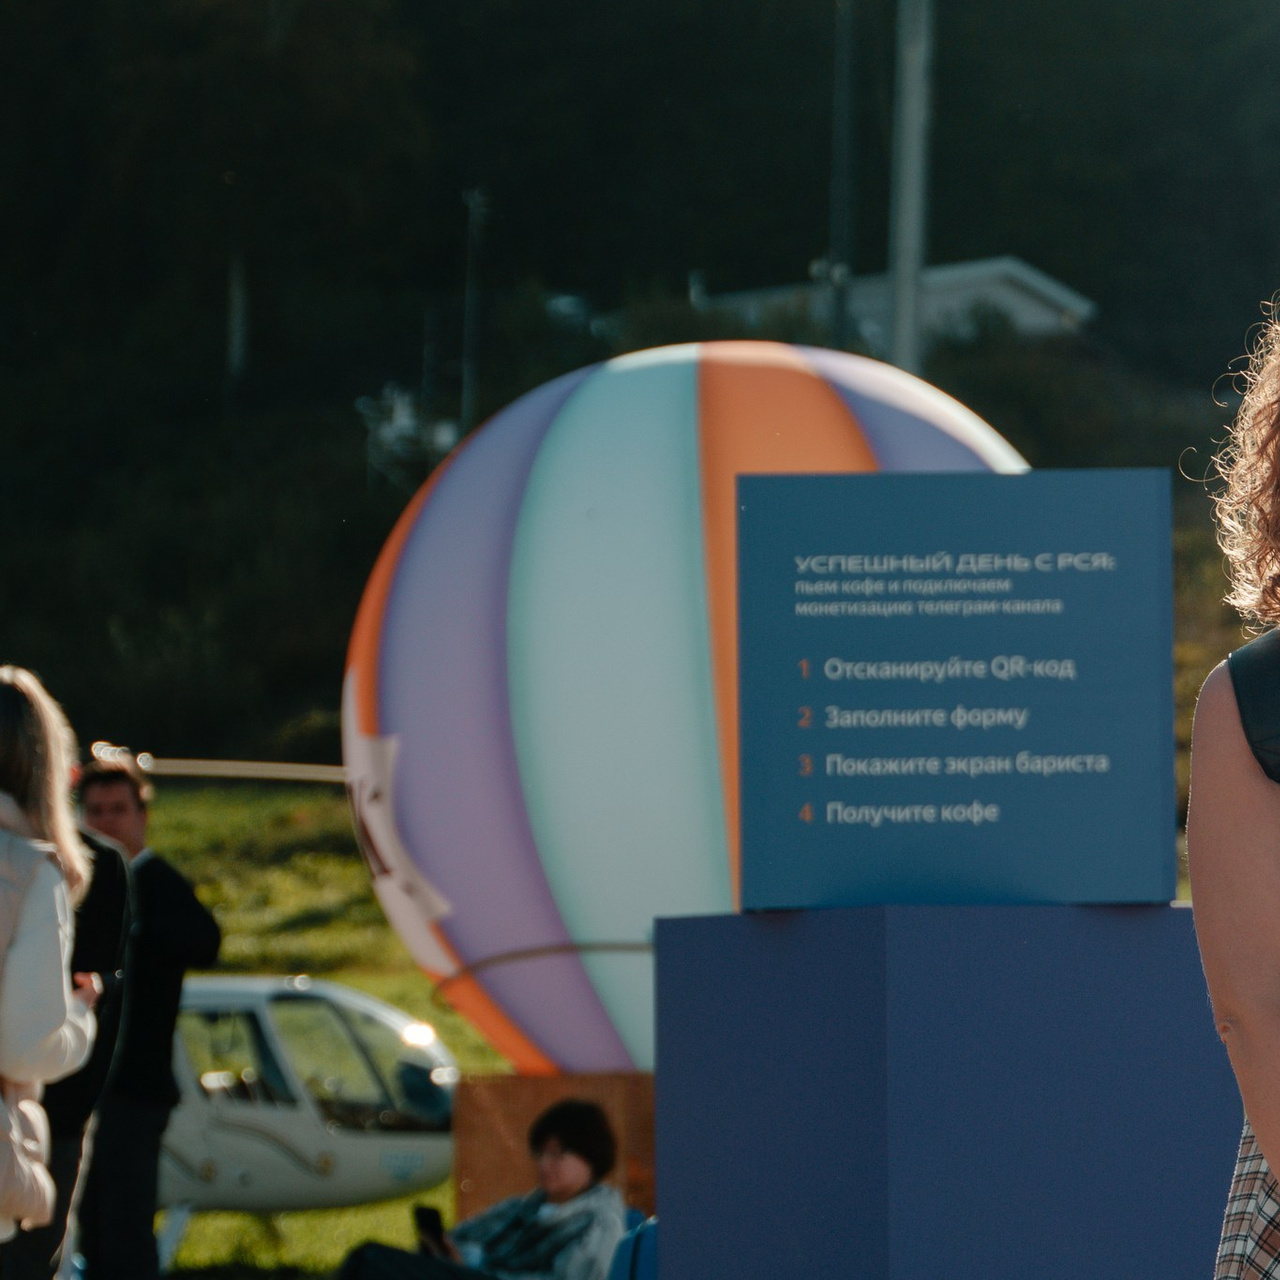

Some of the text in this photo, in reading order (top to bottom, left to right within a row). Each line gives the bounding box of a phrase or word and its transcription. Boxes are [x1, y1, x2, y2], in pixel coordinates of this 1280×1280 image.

[794, 552, 950, 574] УСПЕШНЫЙ
[956, 554, 1030, 574] ДЕНЬ
[1035, 553, 1053, 571] С
[841, 578, 885, 596] кофе
[888, 579, 899, 594] и
[903, 578, 1011, 595] подключаем
[795, 601, 912, 618] монетизацию
[799, 655, 1077, 682] 1 Отсканируйте QR-код
[798, 704, 1028, 730] 2 Заполните форму
[799, 750, 1110, 778] 3 Покажите экран бариста
[799, 800, 1000, 827] 4 Получите кофе
